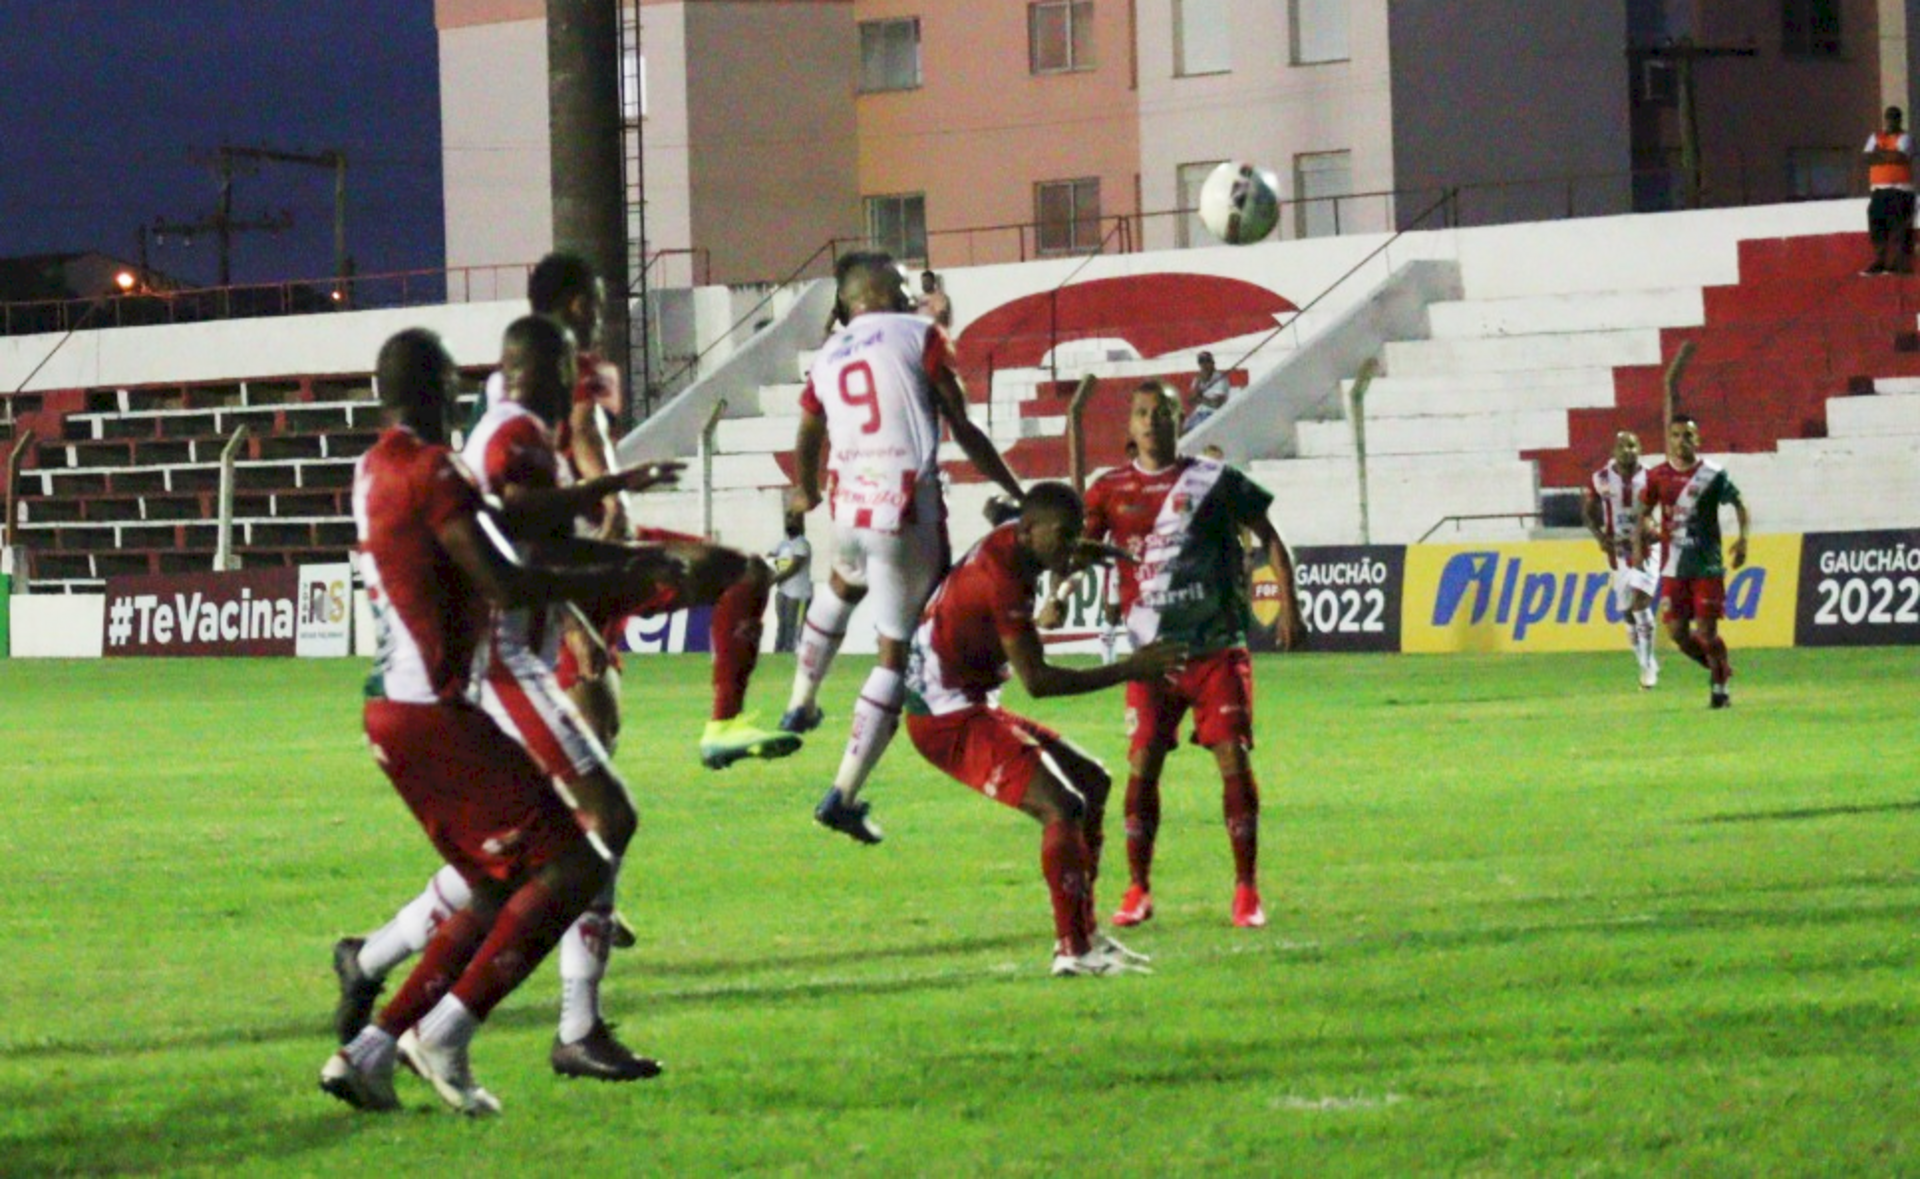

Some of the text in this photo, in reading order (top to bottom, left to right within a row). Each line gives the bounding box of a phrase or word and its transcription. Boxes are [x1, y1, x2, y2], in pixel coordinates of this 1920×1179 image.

[838, 360, 881, 434] 9
[1295, 557, 1387, 585] GAUCHÃO
[1820, 542, 1920, 574] GAUCHÃO
[108, 588, 294, 646] #TeVacina
[1297, 588, 1385, 633] 2022
[1814, 576, 1920, 625] 2022
